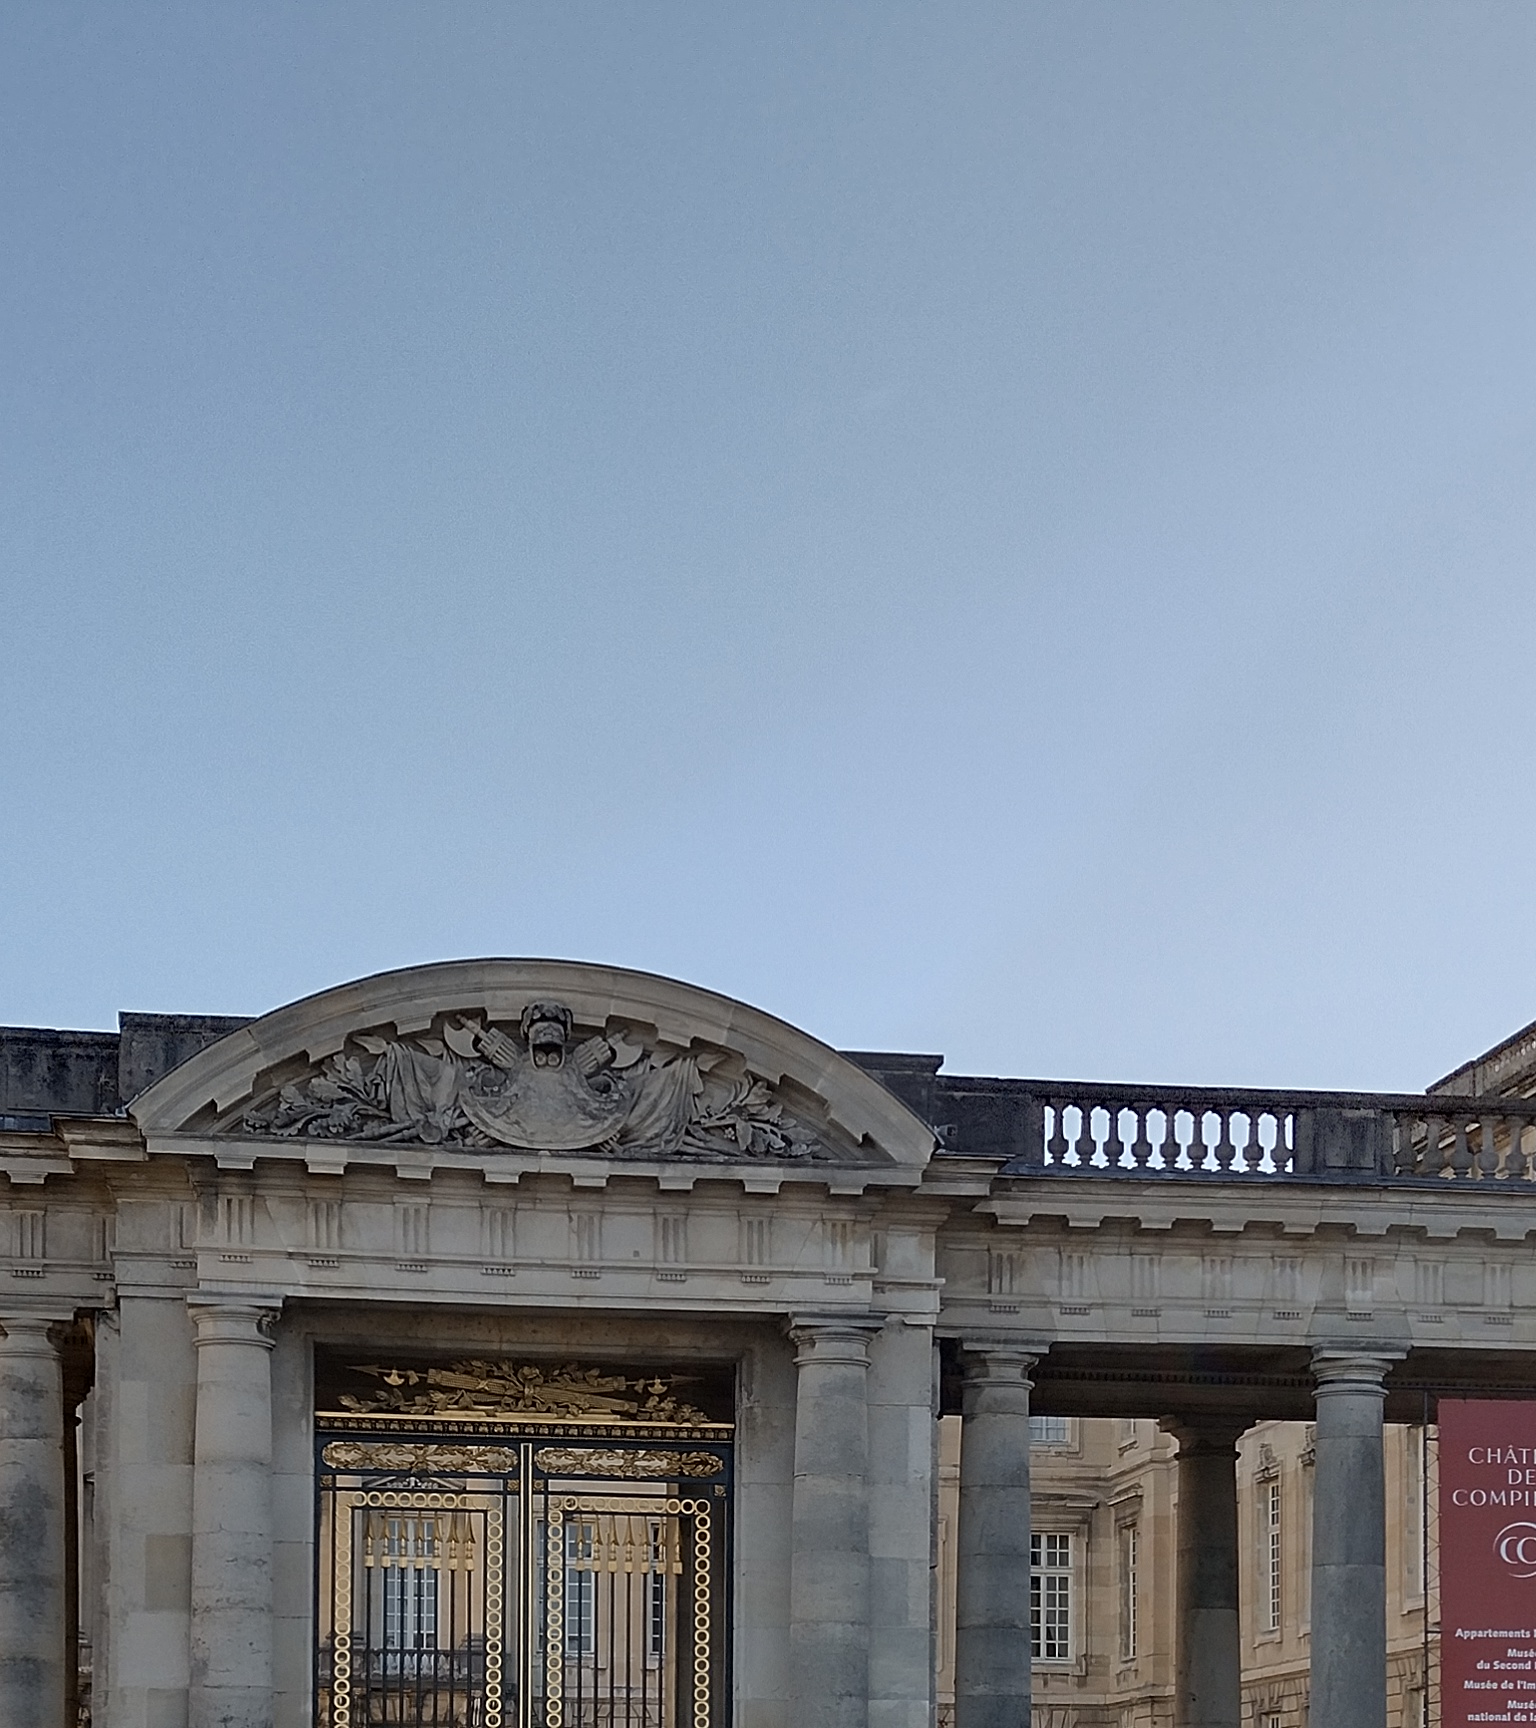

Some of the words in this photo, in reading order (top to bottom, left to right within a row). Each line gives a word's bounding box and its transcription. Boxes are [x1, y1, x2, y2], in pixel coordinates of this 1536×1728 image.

[1508, 1468, 1536, 1486] DE
[1454, 1628, 1531, 1640] Appartements
[1476, 1659, 1491, 1670] du
[1492, 1660, 1532, 1670] Second
[1463, 1679, 1499, 1690] Musée
[1500, 1679, 1515, 1690] de
[1467, 1711, 1511, 1722] national
[1513, 1711, 1528, 1722] de
